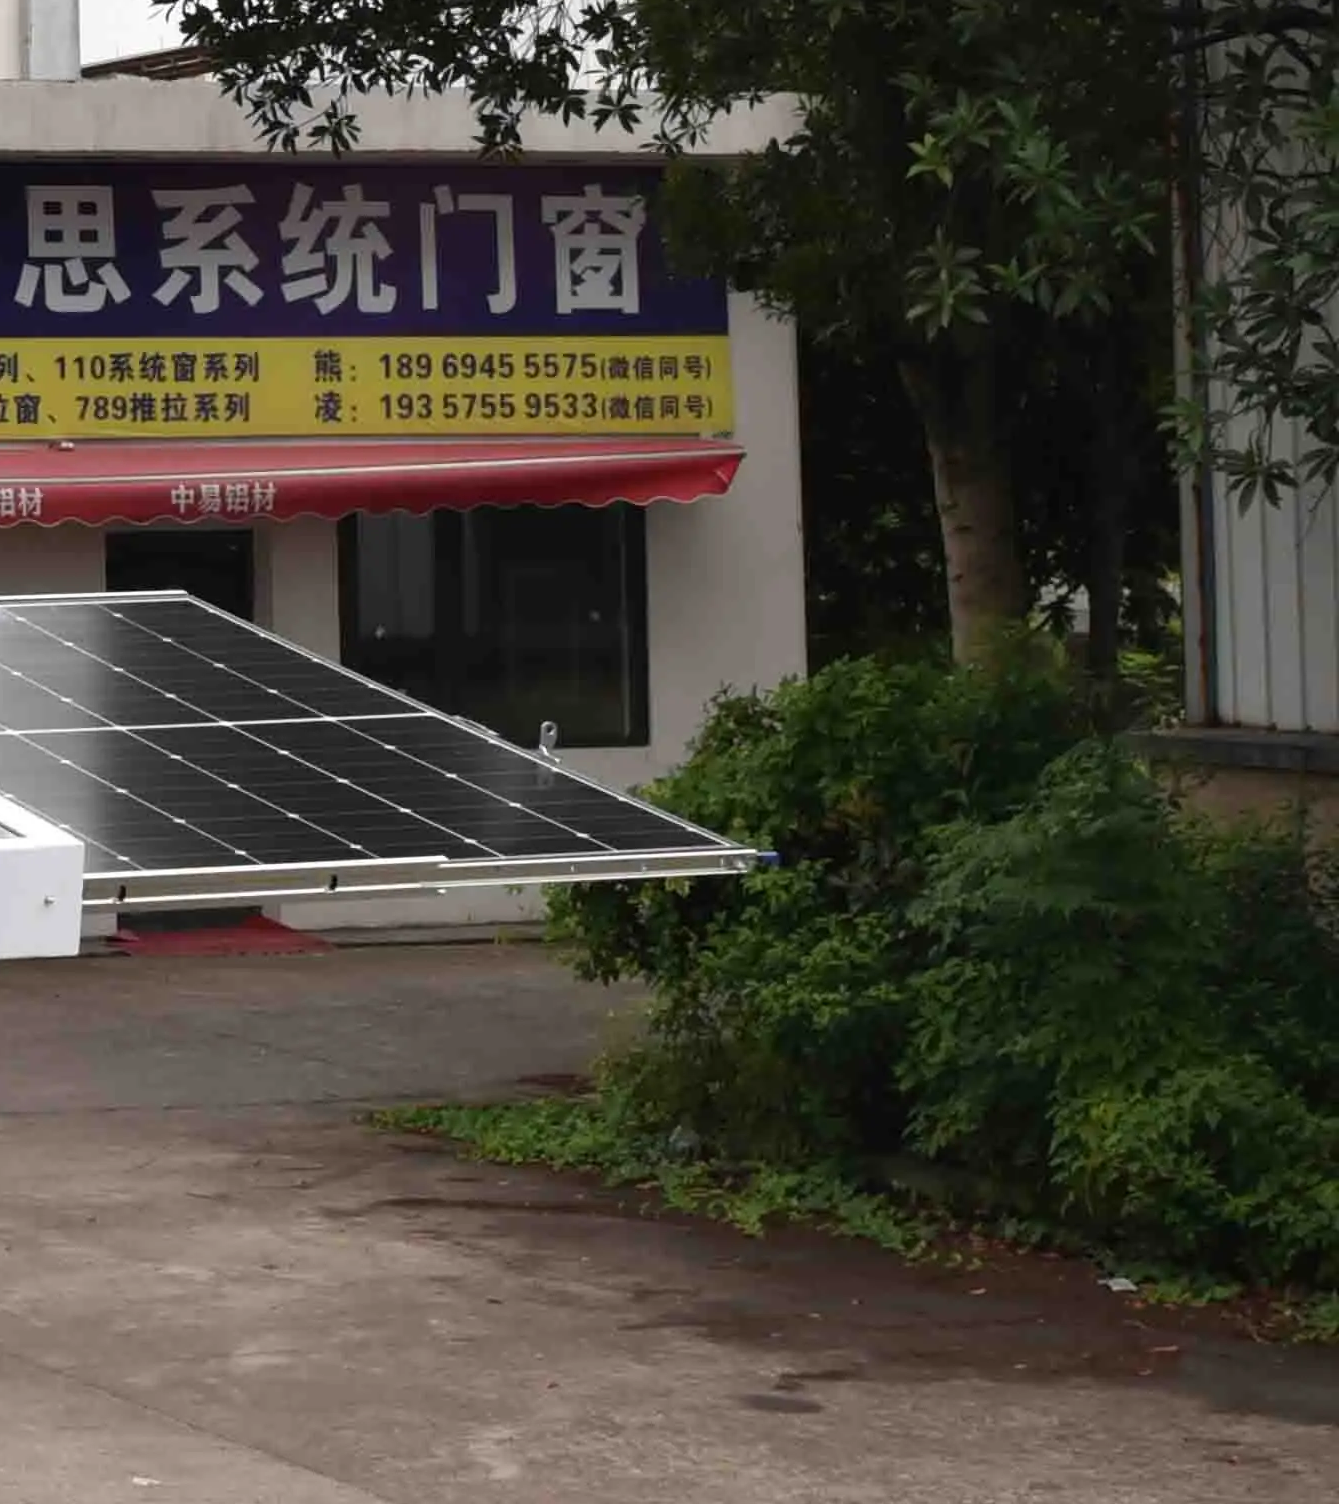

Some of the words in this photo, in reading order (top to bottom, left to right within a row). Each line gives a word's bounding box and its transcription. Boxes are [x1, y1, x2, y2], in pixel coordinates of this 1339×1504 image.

[379, 353, 432, 380] 189
[441, 352, 515, 380] 6945
[379, 393, 433, 420] 193
[441, 393, 516, 420] 5755
[169, 481, 278, 515] 中易铝材
